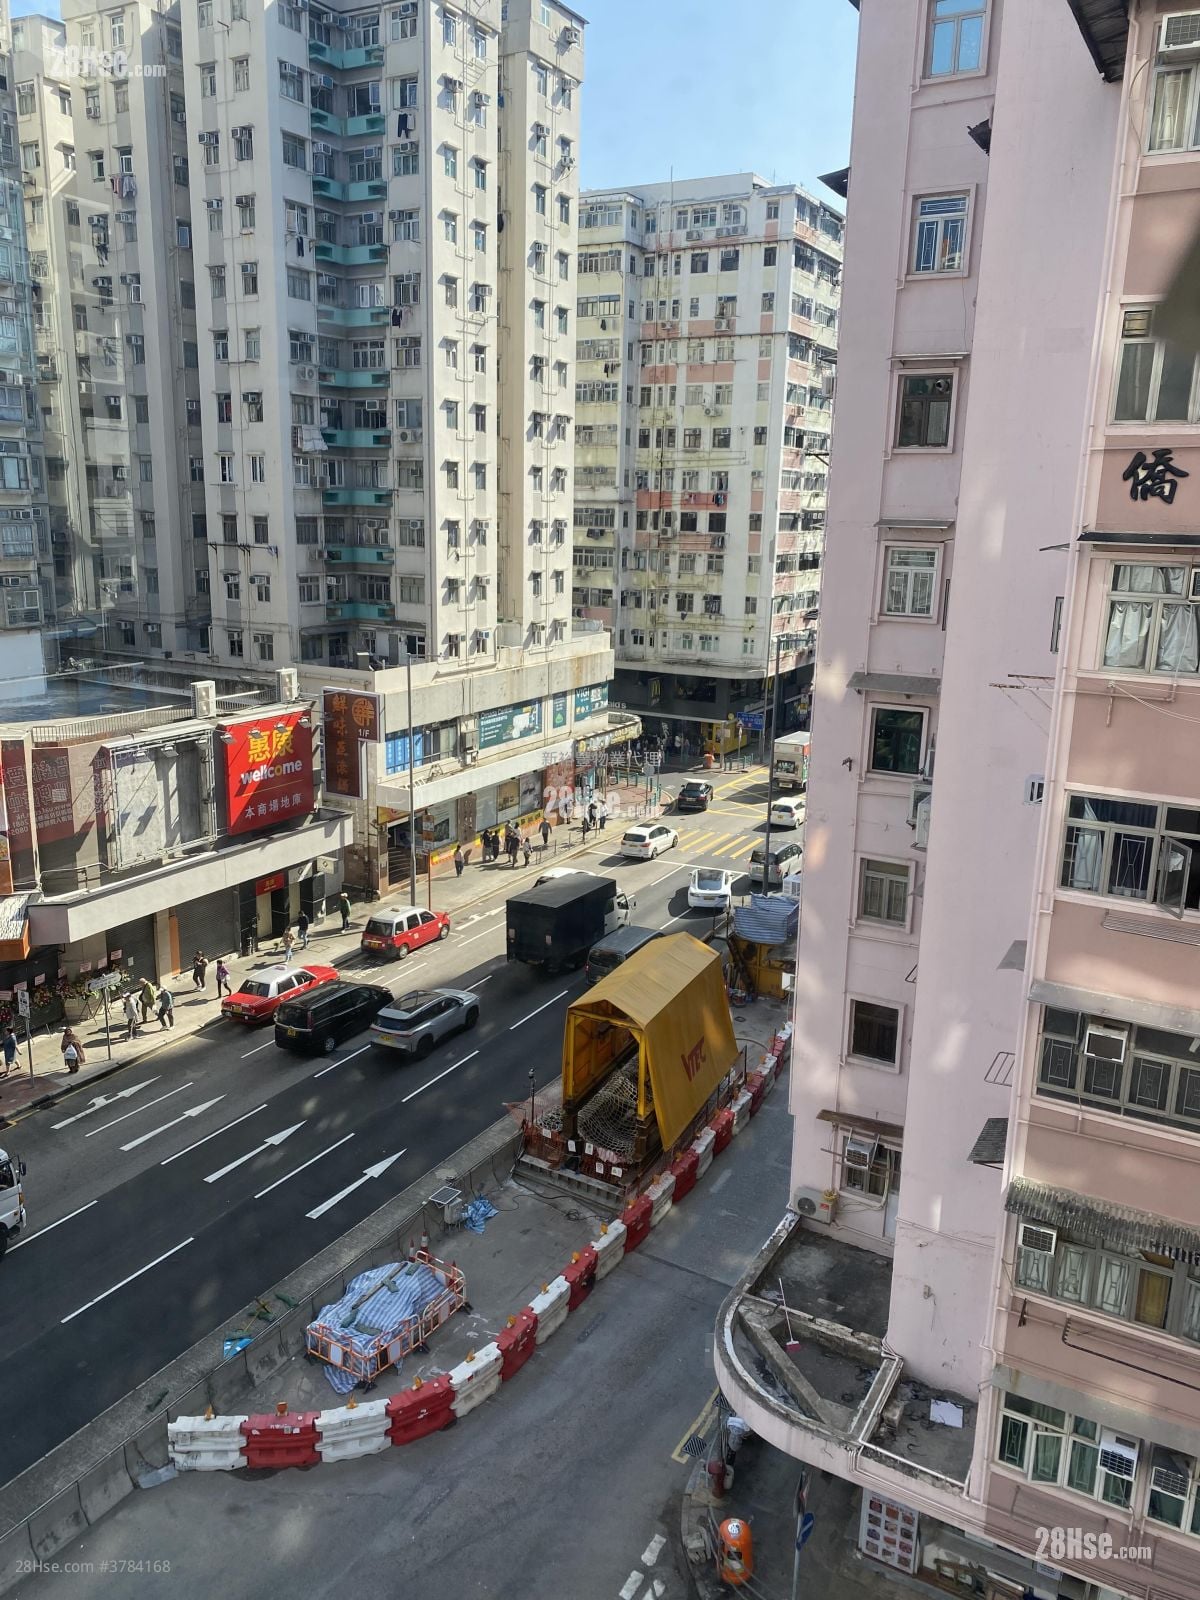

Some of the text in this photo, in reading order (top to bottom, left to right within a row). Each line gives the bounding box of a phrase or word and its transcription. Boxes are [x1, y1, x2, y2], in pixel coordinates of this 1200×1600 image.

[1123, 448, 1190, 505] 僑
[248, 725, 294, 764] 惠康
[358, 728, 370, 738] 1/F
[240, 759, 303, 786] wellcome
[244, 792, 303, 821] 本商場地庫
